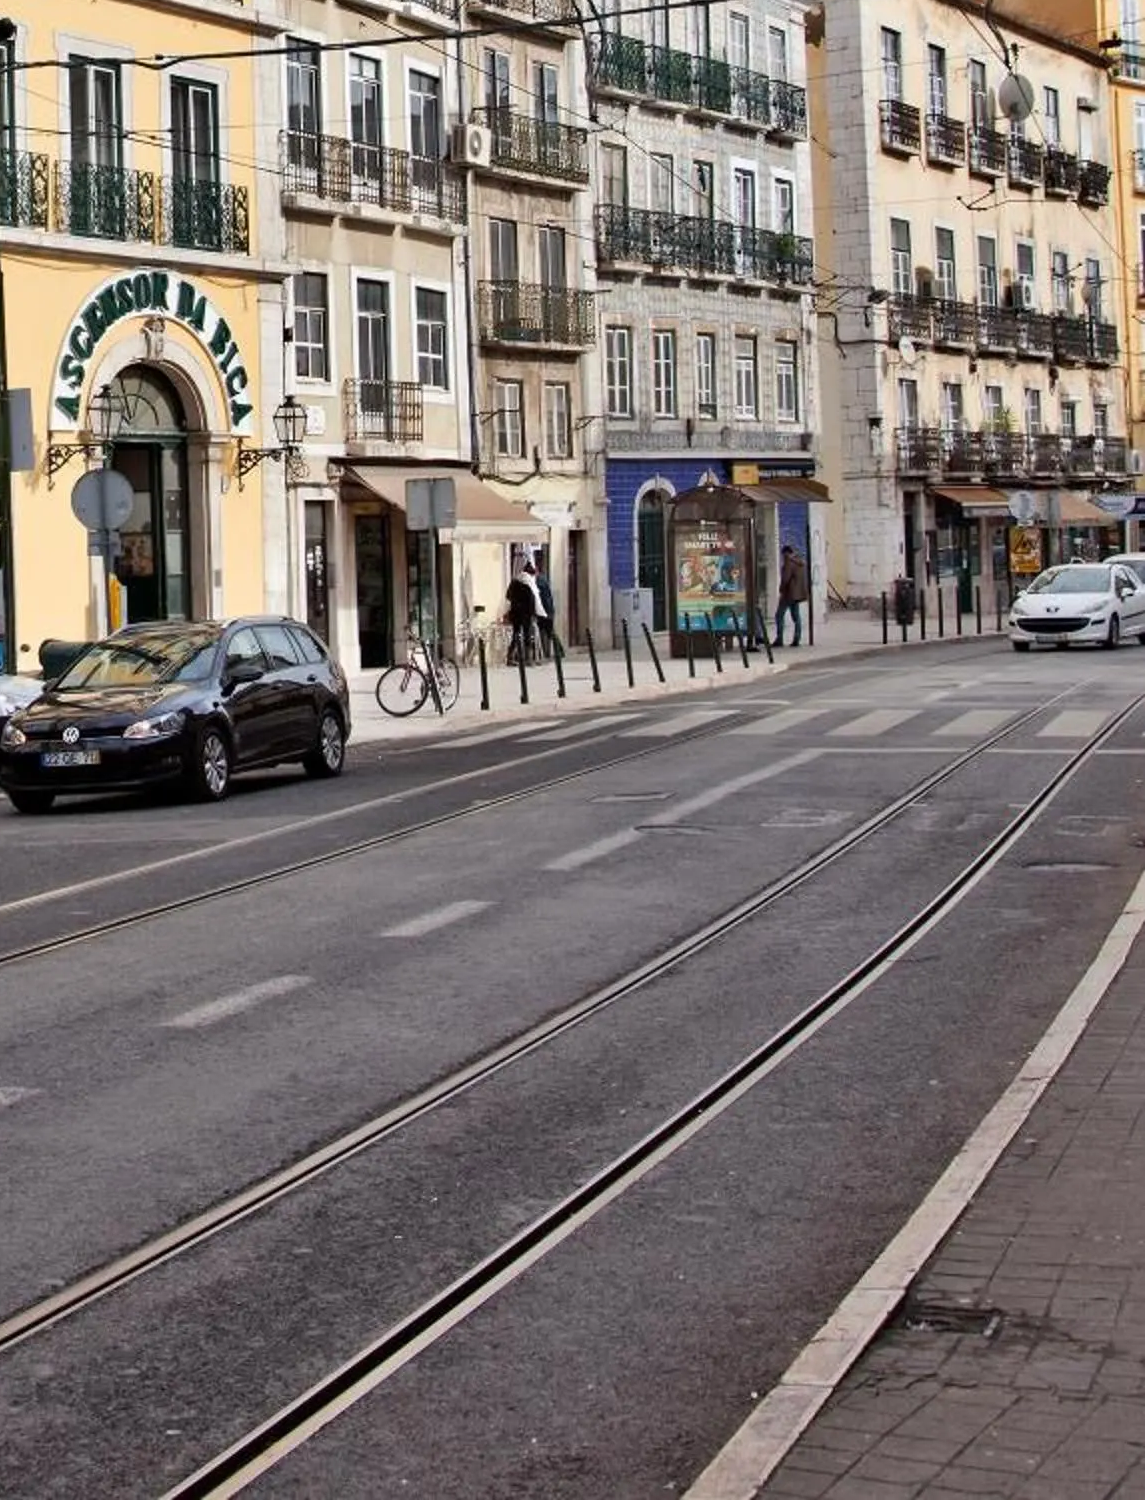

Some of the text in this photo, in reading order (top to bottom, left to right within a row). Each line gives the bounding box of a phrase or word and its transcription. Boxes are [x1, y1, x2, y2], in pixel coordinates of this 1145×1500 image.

[55, 271, 254, 426] ASCENSOR DA BICA
